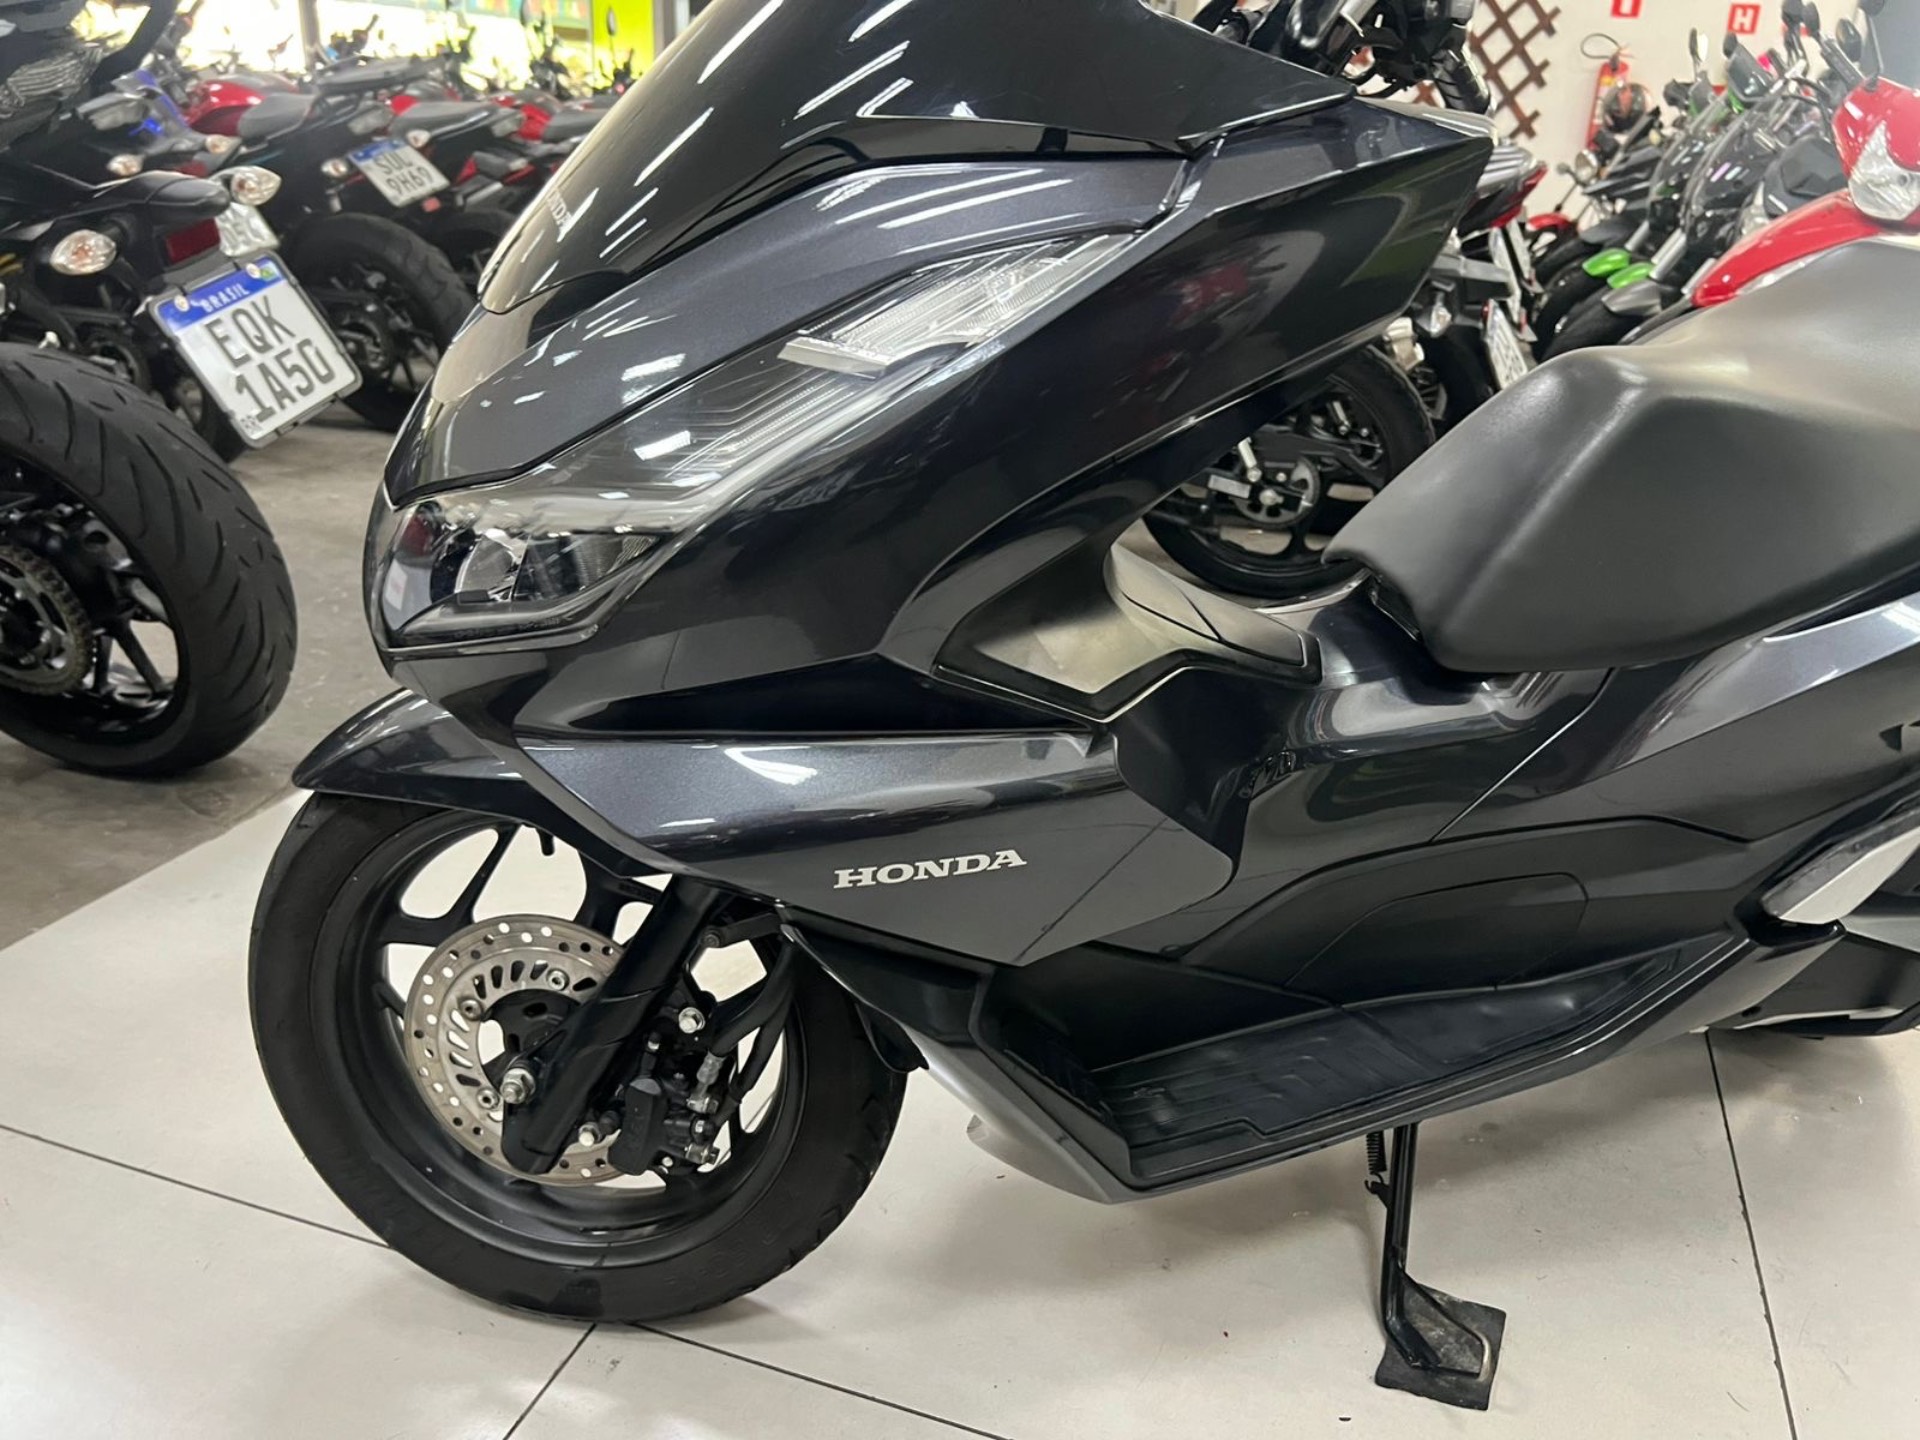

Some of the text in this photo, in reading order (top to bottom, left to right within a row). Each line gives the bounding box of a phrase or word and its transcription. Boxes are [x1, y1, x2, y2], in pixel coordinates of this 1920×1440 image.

[203, 283, 249, 313] BRASIL
[204, 295, 296, 368] EQK
[235, 338, 335, 423] 1A50
[833, 849, 1027, 888] HONDA
